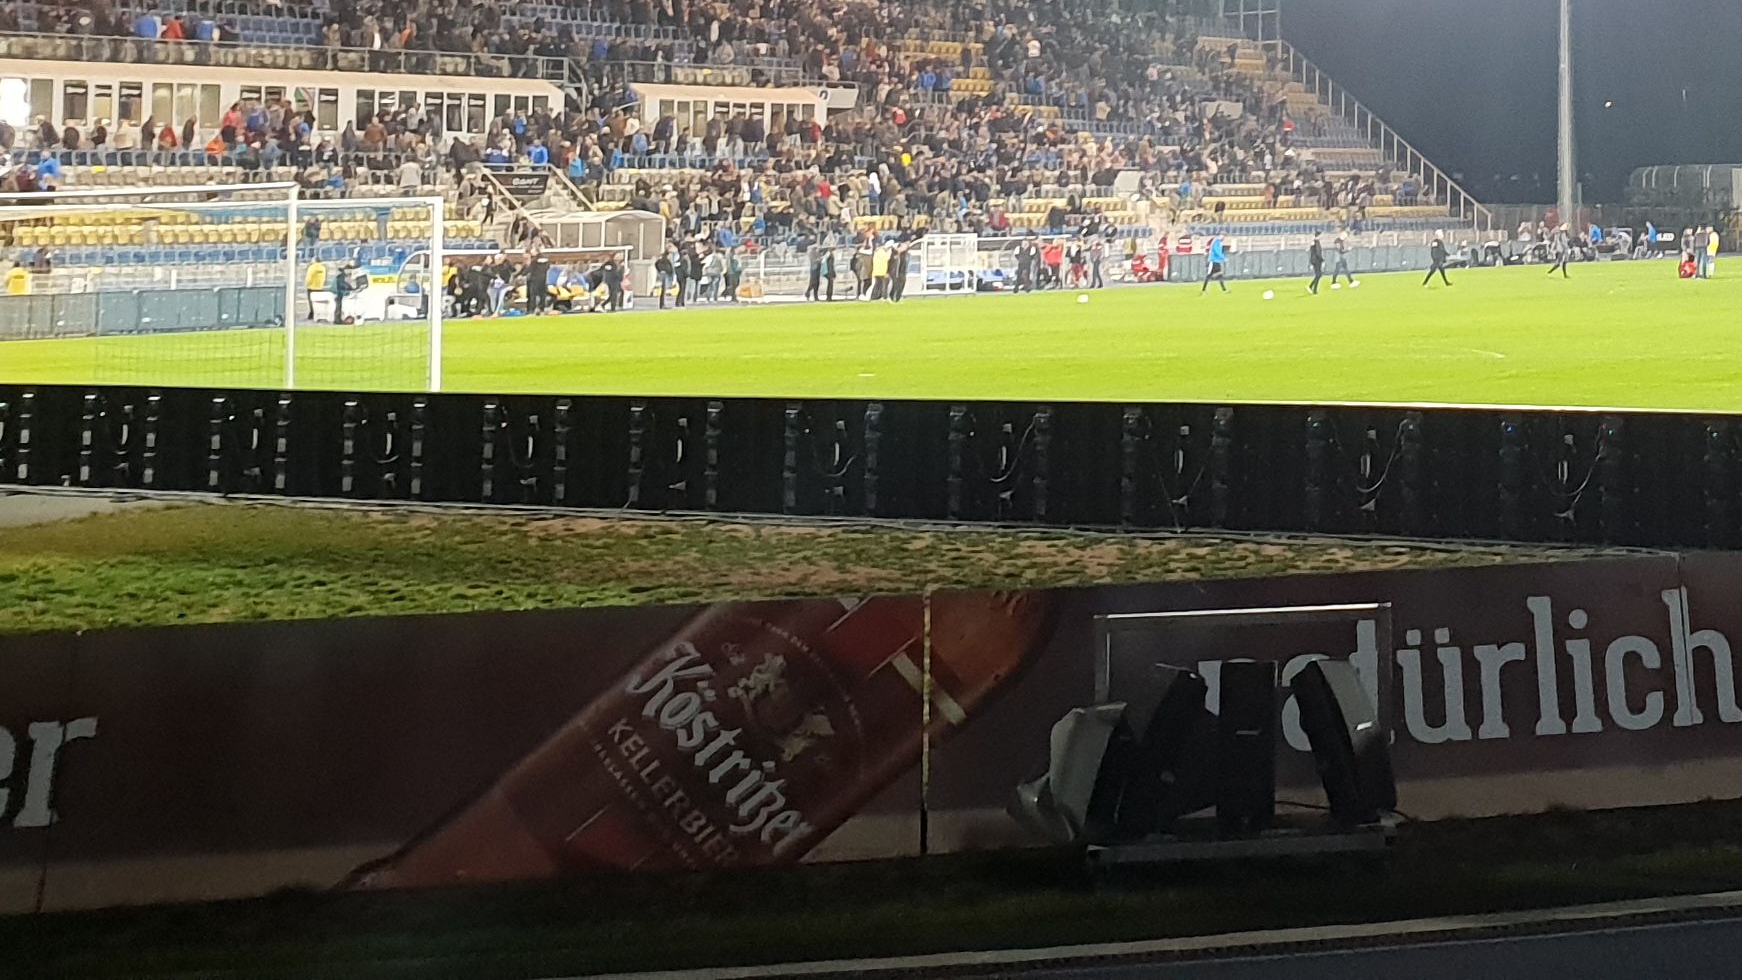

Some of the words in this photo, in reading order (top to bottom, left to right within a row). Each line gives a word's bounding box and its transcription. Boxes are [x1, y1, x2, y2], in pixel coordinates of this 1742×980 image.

[626, 640, 816, 858] Köstritzer
[1198, 587, 1742, 753] türlich
[606, 717, 741, 863] KELLERBIER
